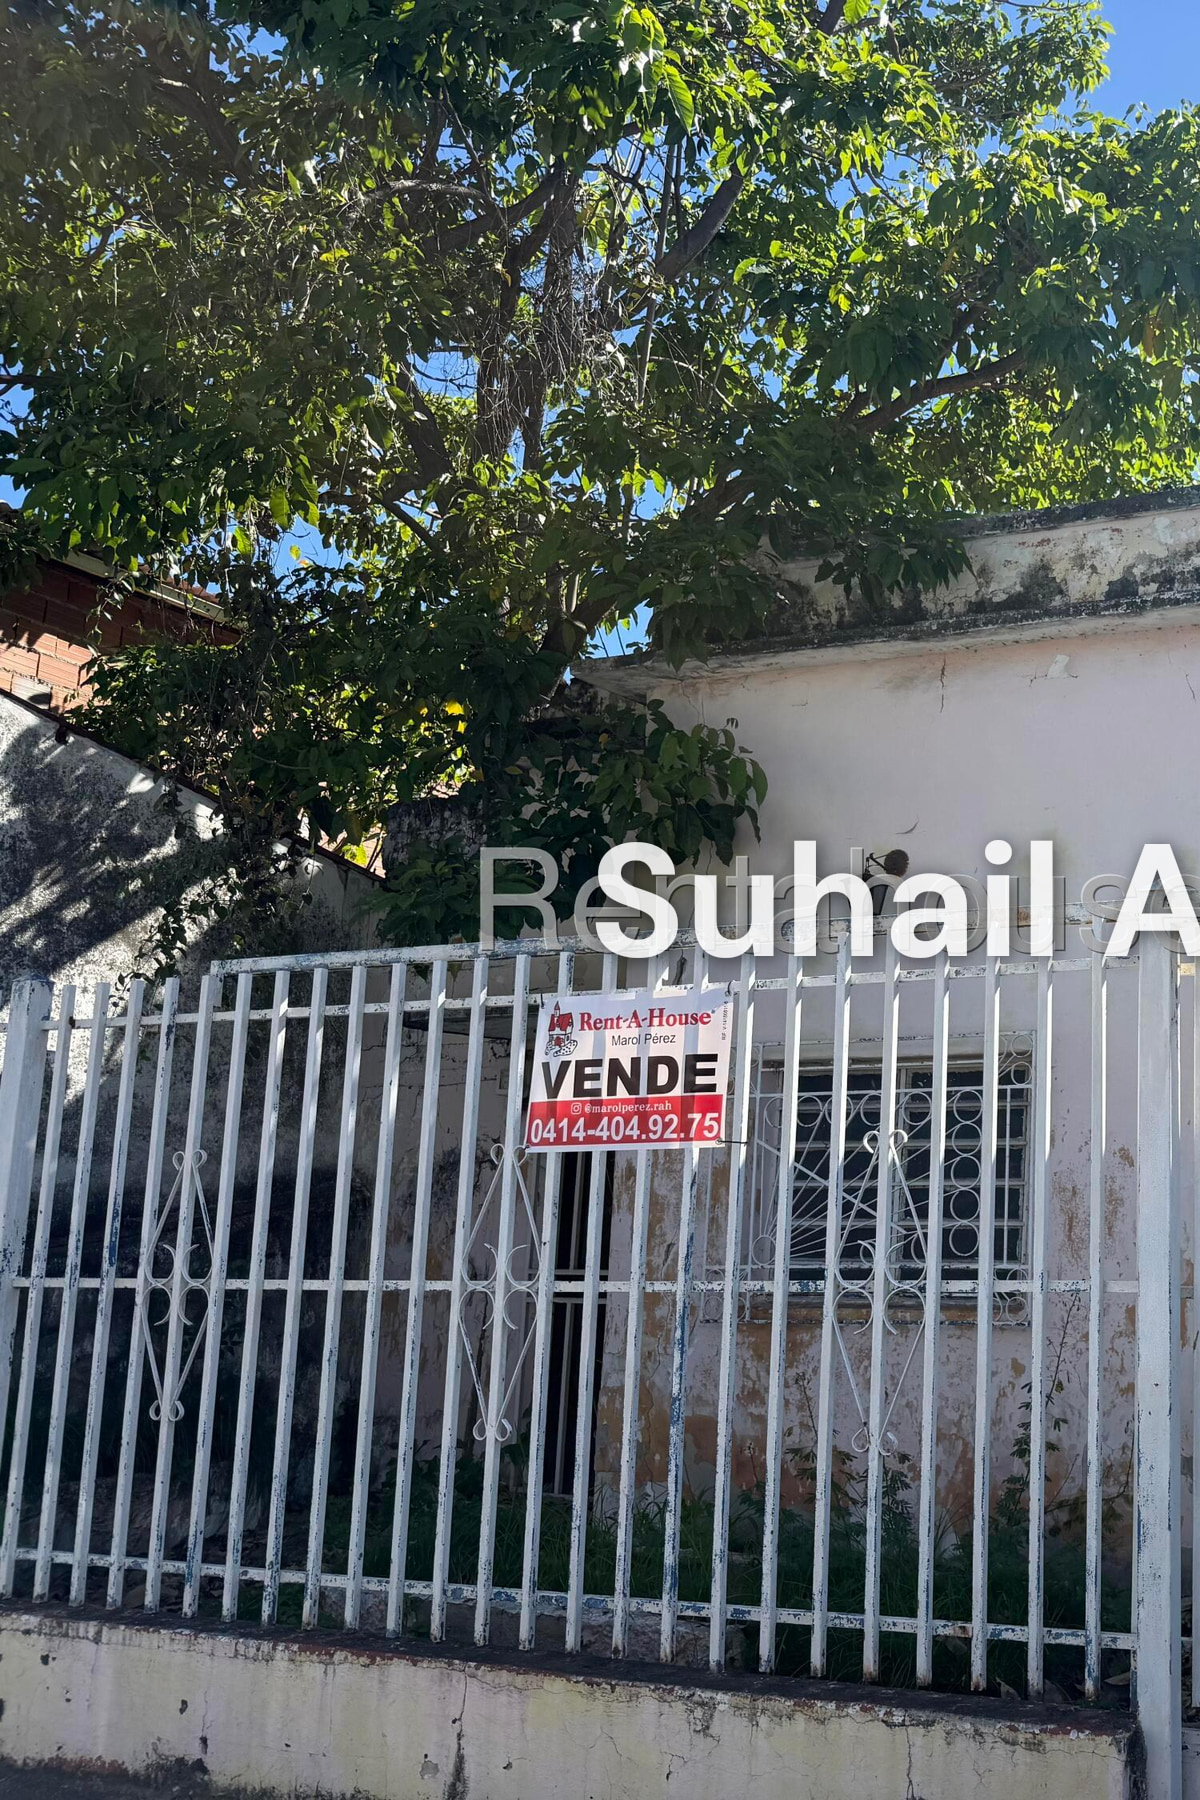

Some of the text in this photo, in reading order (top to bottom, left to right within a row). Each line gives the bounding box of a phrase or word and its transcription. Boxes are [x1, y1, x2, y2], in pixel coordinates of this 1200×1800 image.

[578, 1007, 712, 1032] Rent-A-House
[611, 1032, 676, 1046] Marol Pérez
[541, 1053, 719, 1099] VENDE
[584, 1100, 672, 1115] @marolperez.rah
[530, 1112, 720, 1144] 0414-404.92.75
